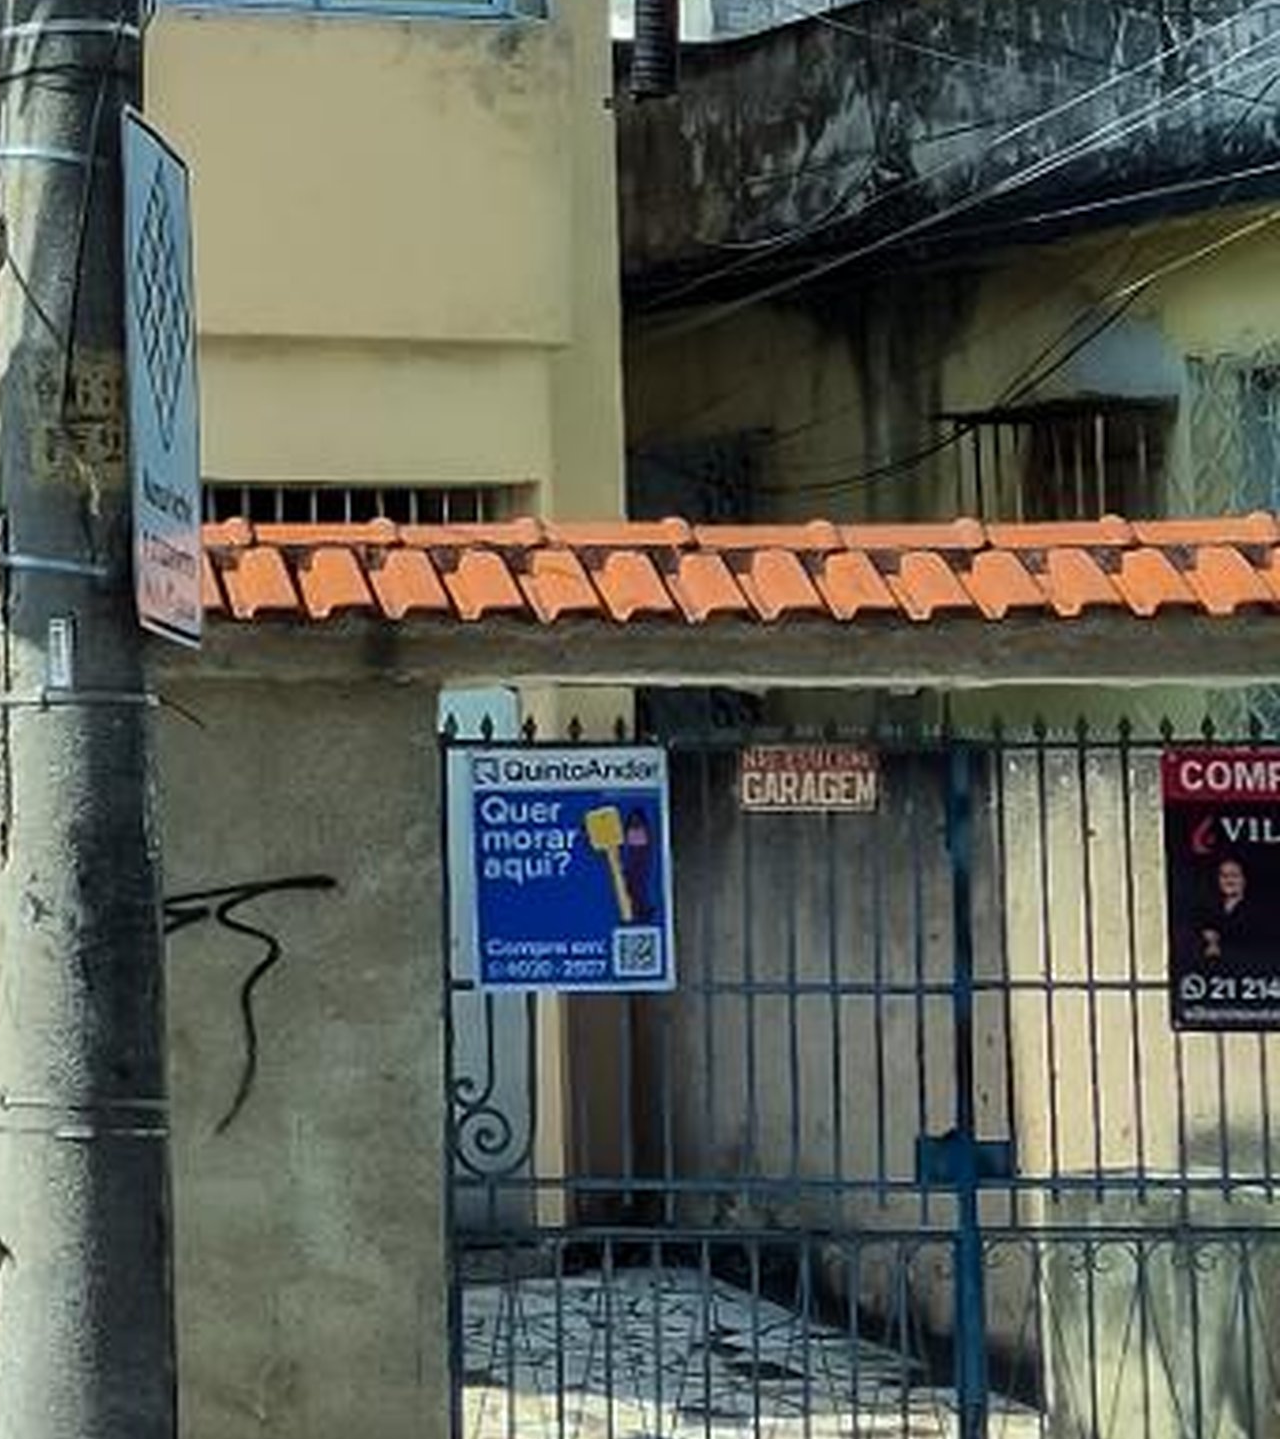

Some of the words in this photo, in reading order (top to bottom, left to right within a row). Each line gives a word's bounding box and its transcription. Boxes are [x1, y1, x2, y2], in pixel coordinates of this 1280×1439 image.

[503, 759, 658, 781] QuintoAndar
[743, 772, 876, 805] GARAGEM
[480, 795, 562, 823] Quer
[482, 828, 579, 850] morar
[483, 851, 572, 884] aqui?
[1209, 976, 1236, 1000] 21
